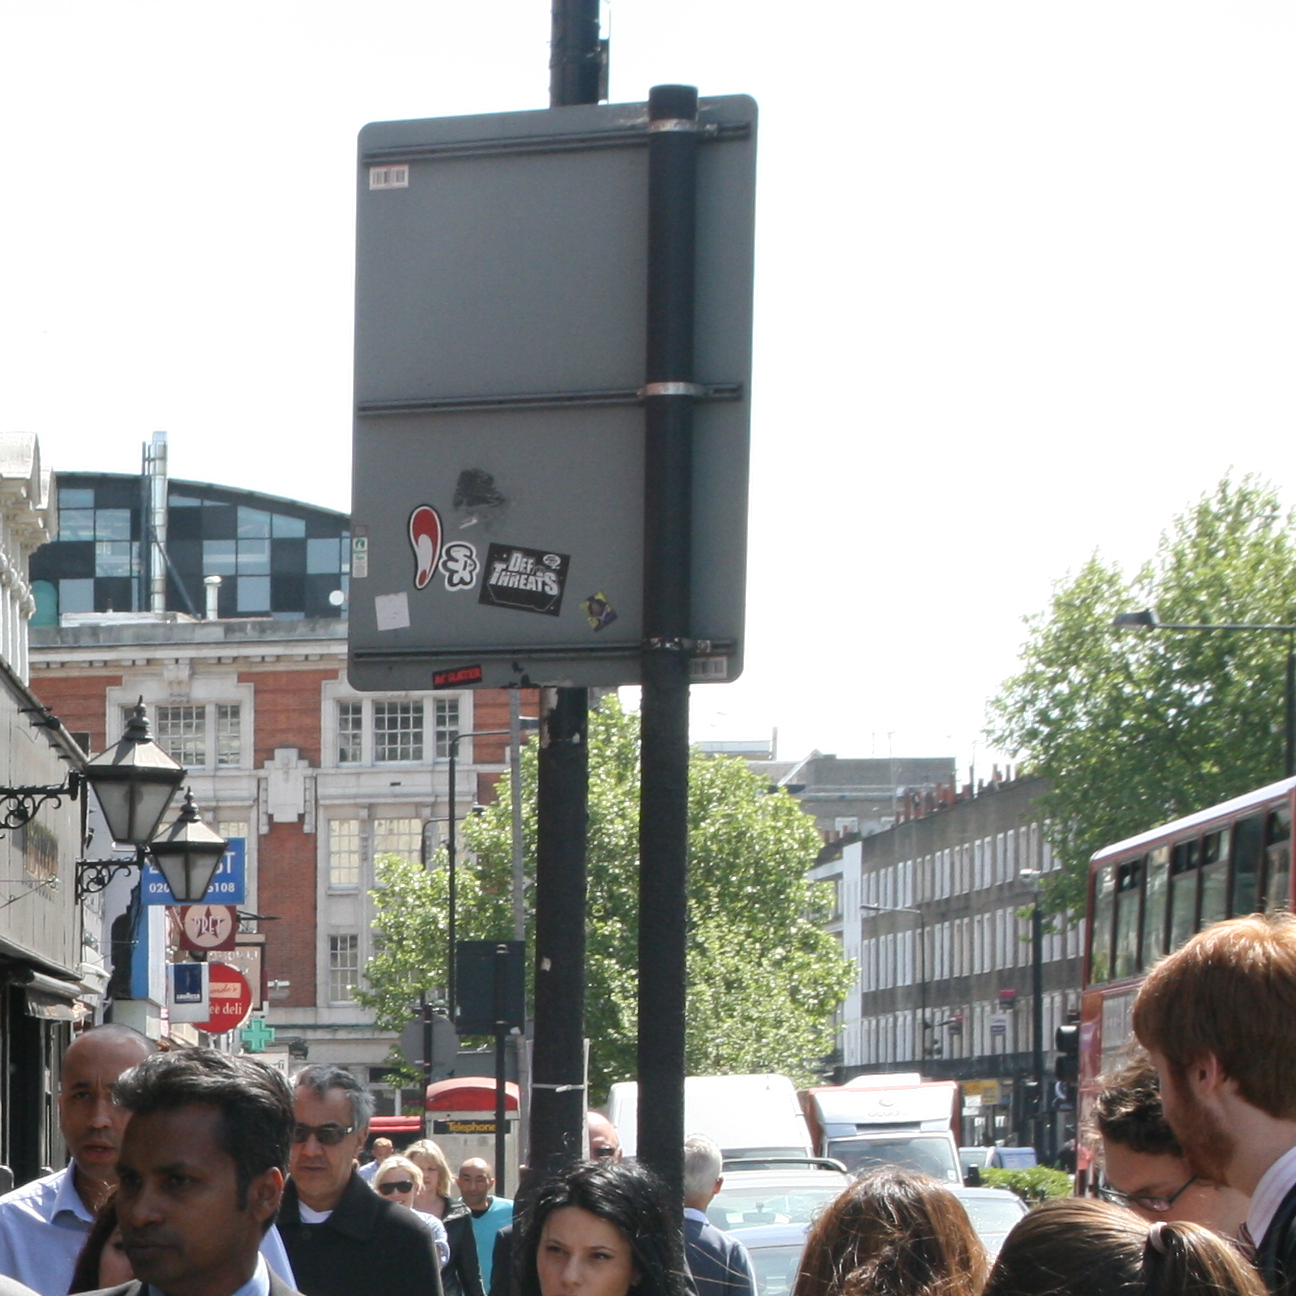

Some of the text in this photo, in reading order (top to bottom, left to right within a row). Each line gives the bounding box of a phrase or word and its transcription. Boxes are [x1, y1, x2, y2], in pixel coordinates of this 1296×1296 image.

[509, 551, 535, 574] DEF
[489, 561, 560, 596] THREATS
[193, 915, 223, 935] PRET
[223, 1001, 242, 1015] deli
